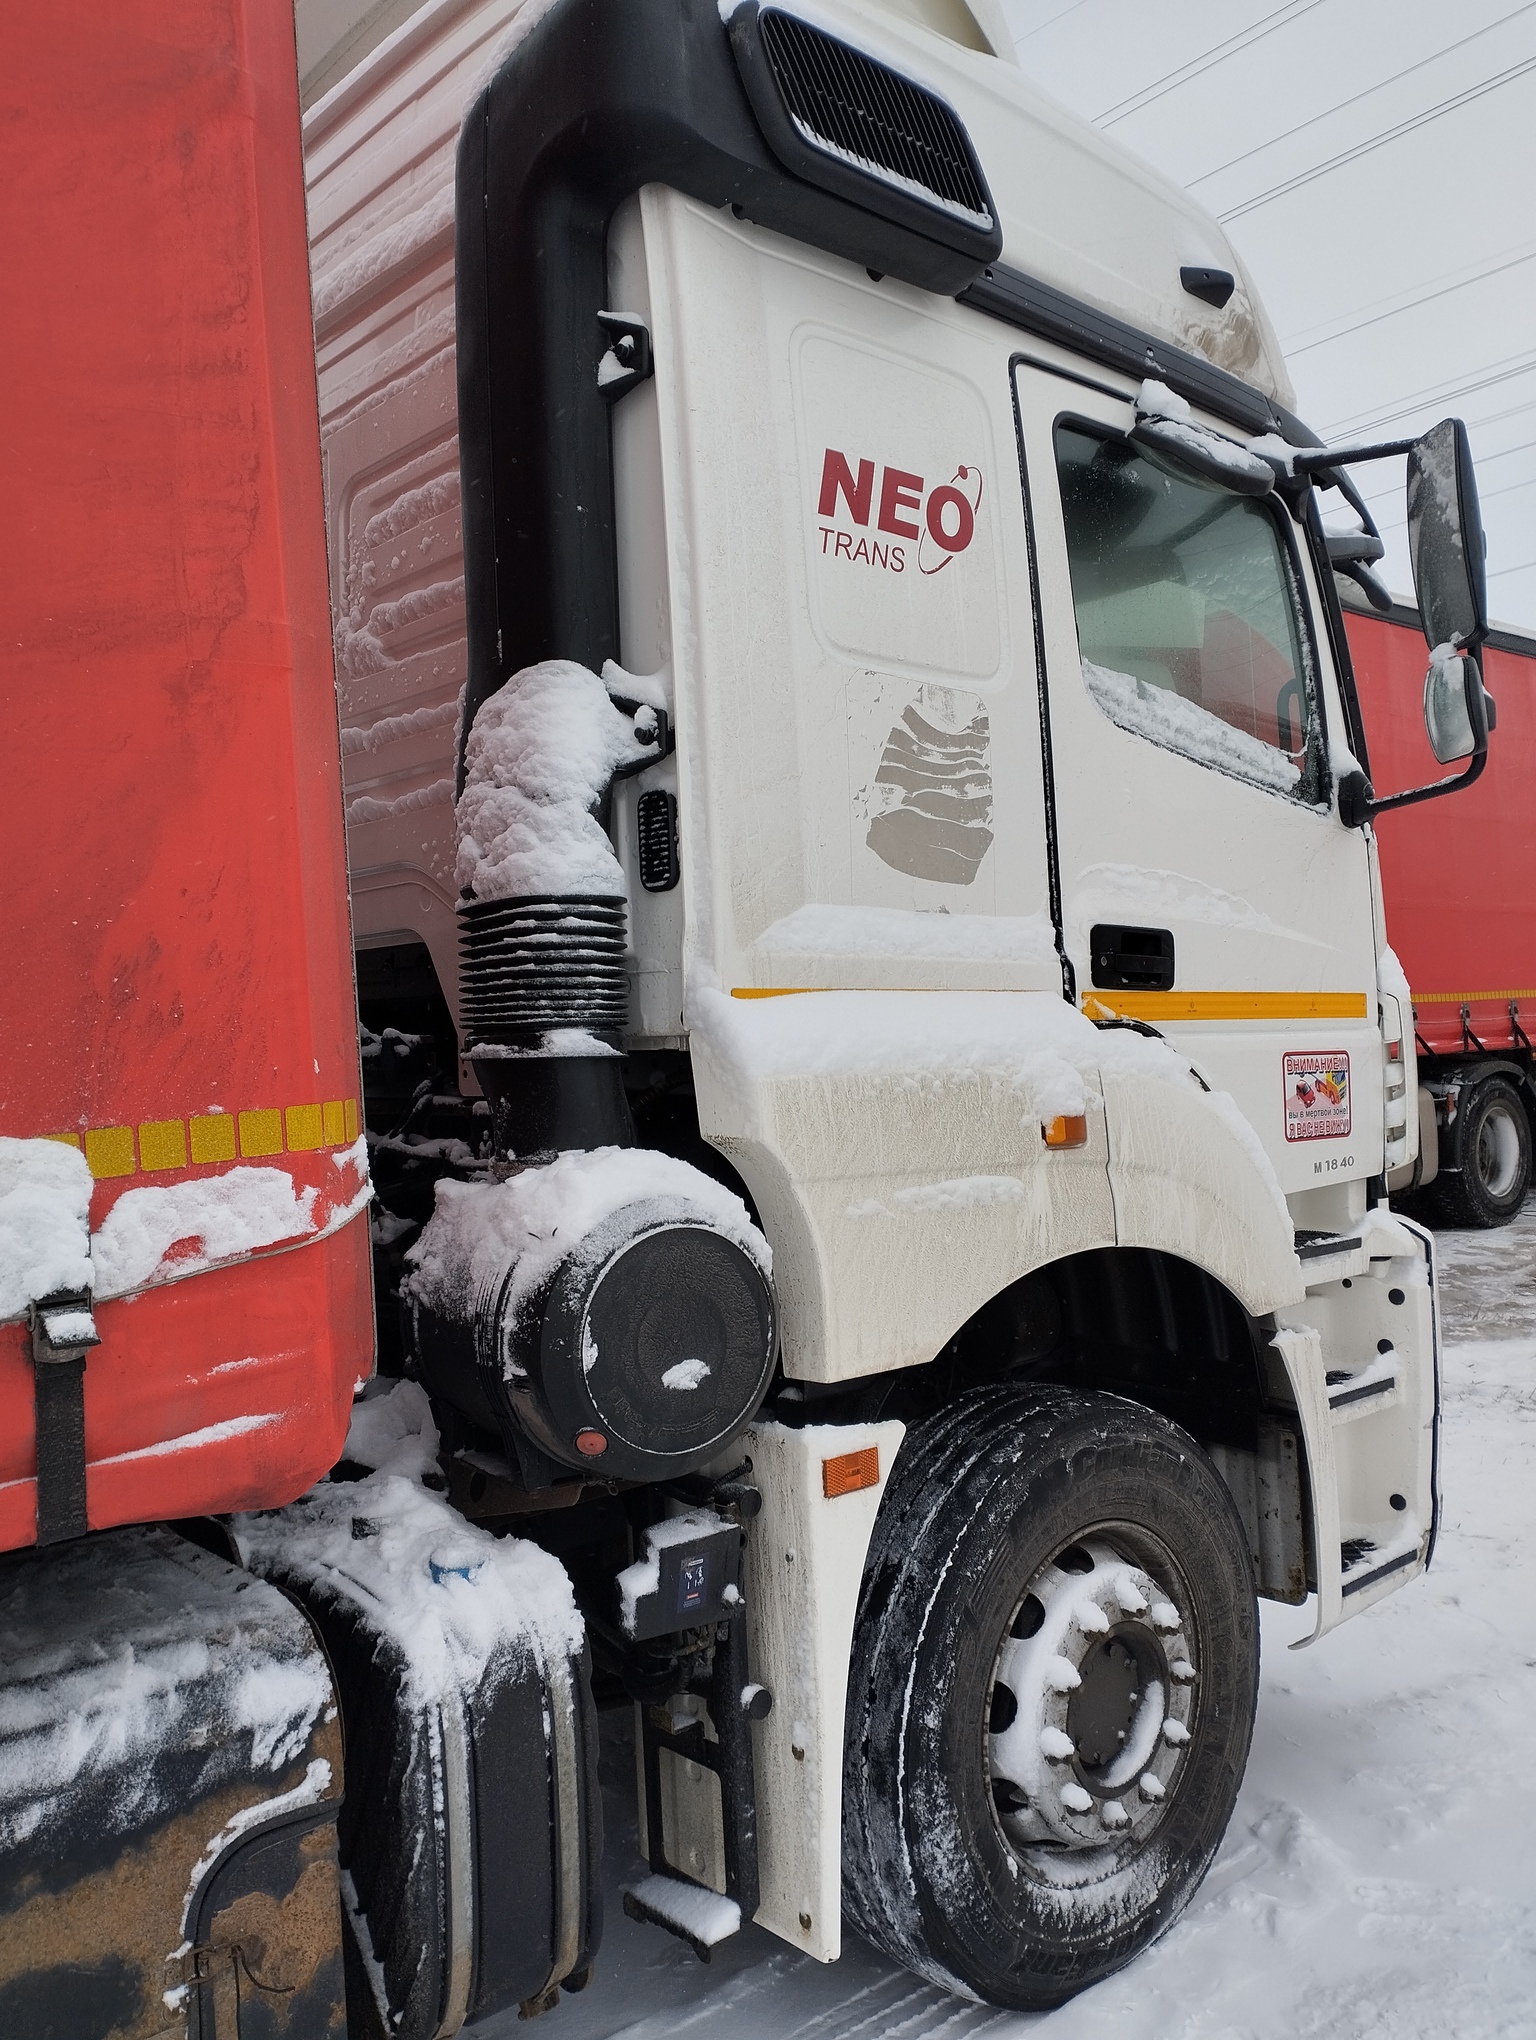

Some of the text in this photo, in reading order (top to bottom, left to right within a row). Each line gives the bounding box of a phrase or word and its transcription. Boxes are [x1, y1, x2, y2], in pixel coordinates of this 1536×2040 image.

[818, 447, 975, 553] NEO
[818, 526, 906, 573] TRANS
[1296, 1121, 1313, 1136] ВАС
[1313, 1120, 1325, 1134] НЕ
